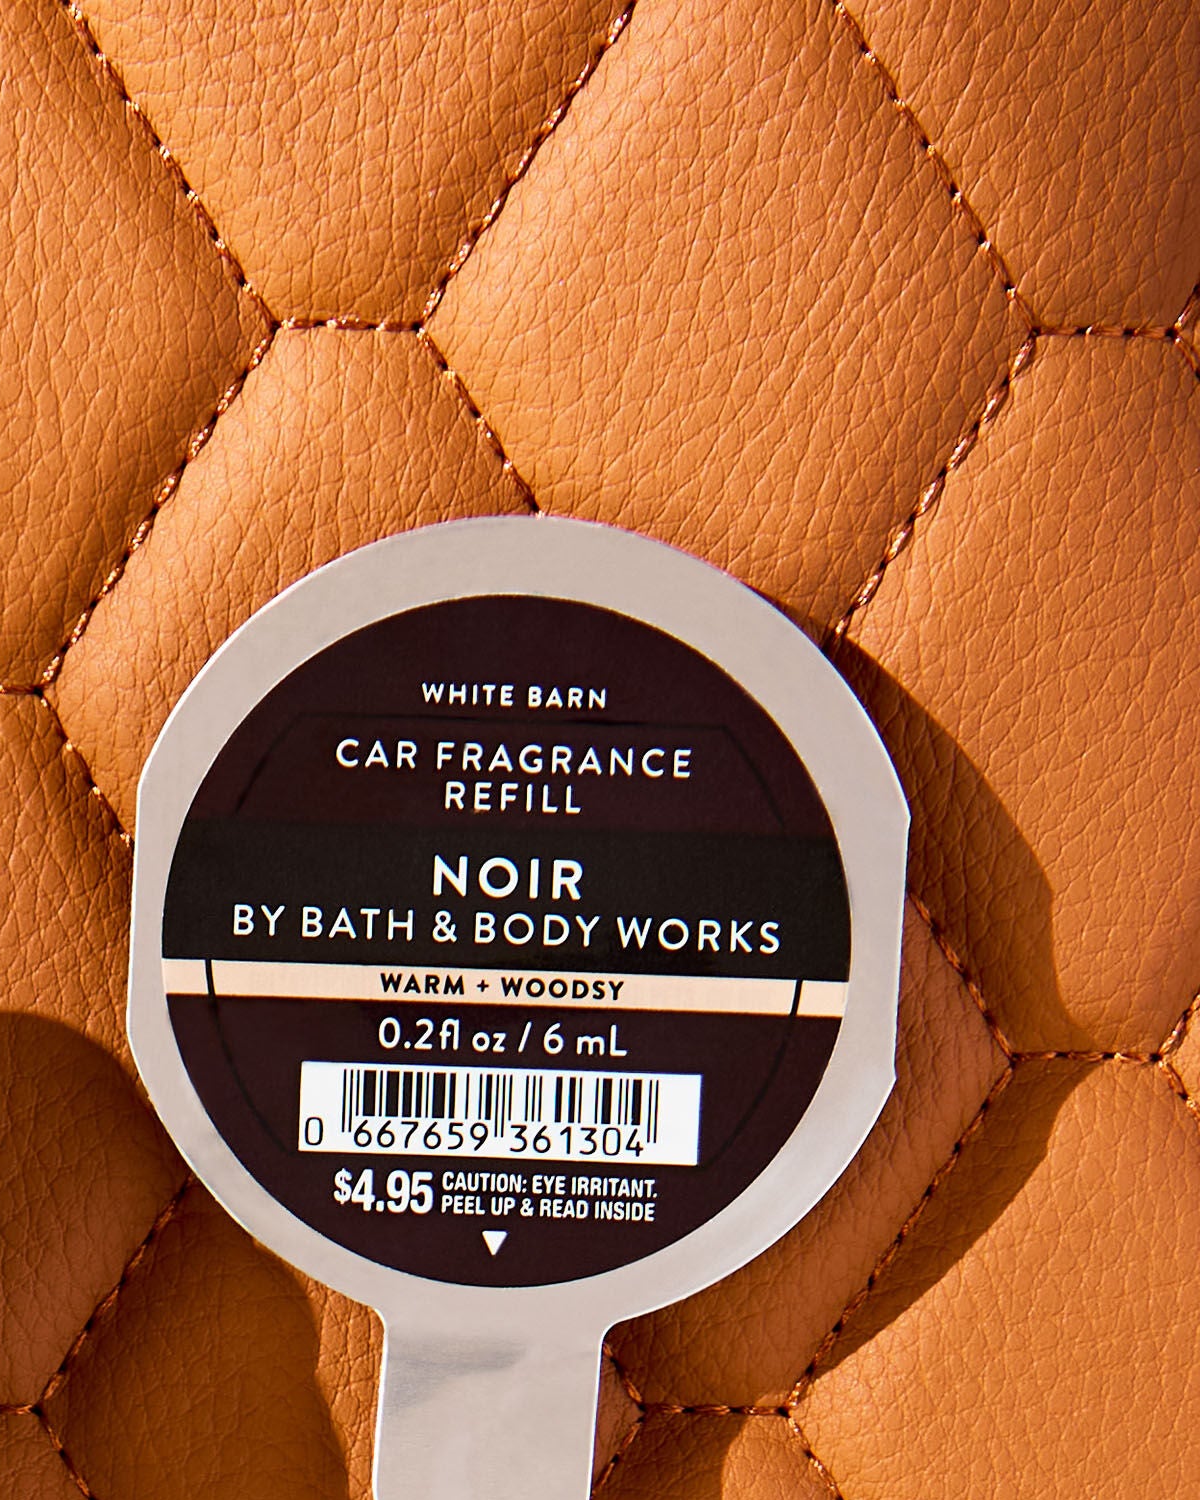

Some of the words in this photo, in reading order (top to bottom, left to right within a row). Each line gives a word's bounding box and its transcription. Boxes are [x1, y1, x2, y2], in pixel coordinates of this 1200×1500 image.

[421, 682, 514, 707] WHITE
[528, 686, 606, 709] BARN
[335, 738, 417, 769] CAR
[436, 741, 691, 778] FRAGRANCE
[444, 781, 581, 814] REFILL
[433, 855, 583, 900] NOIR
[233, 904, 285, 936] BY
[302, 906, 413, 941] BATH
[432, 910, 458, 943] &
[474, 912, 600, 947] BODY
[616, 916, 780, 954] WORKS
[380, 972, 465, 996] WARM
[476, 979, 490, 993] +
[500, 976, 624, 1001] WOODSY
[472, 1032, 506, 1052] oz
[518, 1021, 532, 1053] /
[543, 1023, 564, 1055] 6
[576, 1024, 627, 1057] mL
[304, 1116, 324, 1146] 0
[353, 1119, 489, 1152] 667659
[509, 1124, 644, 1157] 361304
[333, 1167, 434, 1214] $4.95
[442, 1171, 527, 1194] CAUTION:
[532, 1174, 566, 1195] EYE
[571, 1176, 658, 1198] IRRITANT.
[441, 1194, 486, 1215] PEEL
[491, 1196, 516, 1216] UP
[520, 1197, 534, 1217] &
[539, 1198, 589, 1219] READ
[594, 1200, 655, 1222] INSIDE
